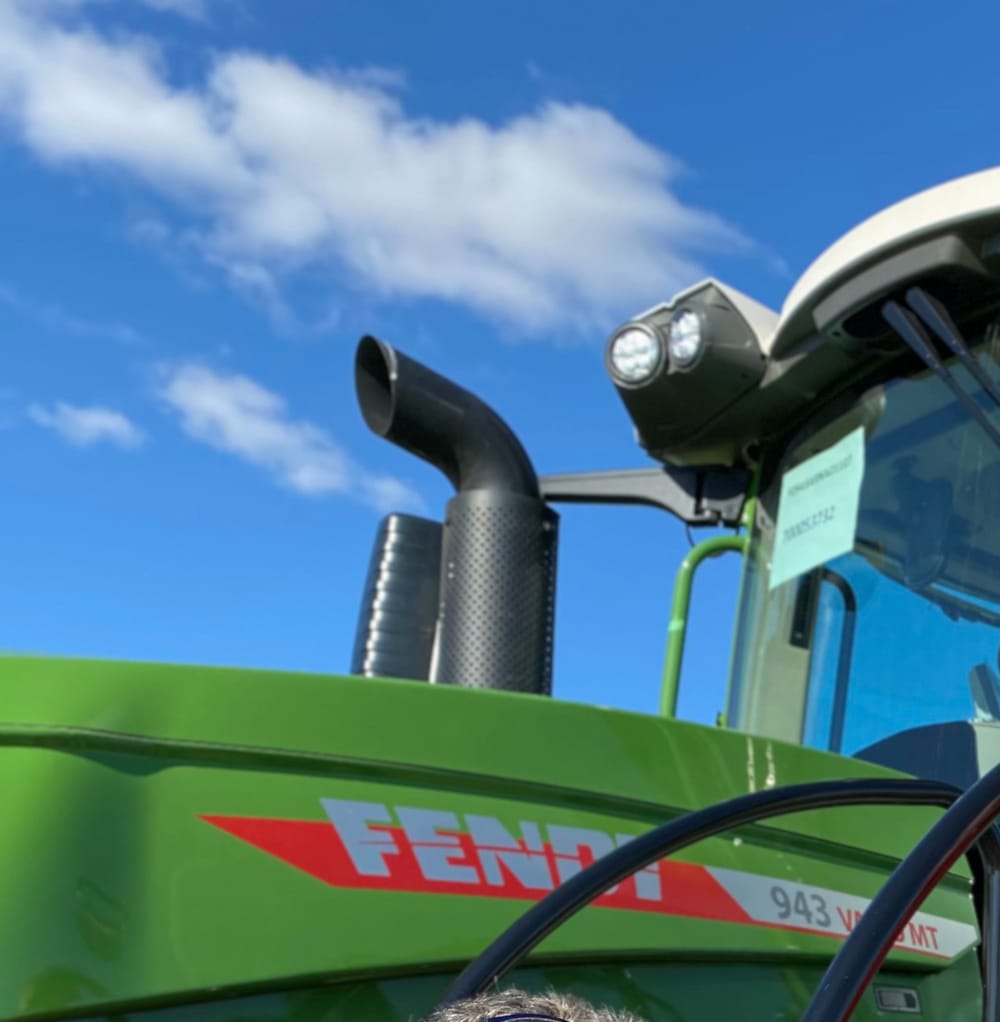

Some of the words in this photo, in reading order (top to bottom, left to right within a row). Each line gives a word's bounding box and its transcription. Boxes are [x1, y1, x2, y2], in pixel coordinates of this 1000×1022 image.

[320, 797, 662, 901] FENDT
[769, 886, 832, 928] 943
[908, 921, 939, 951] MT
